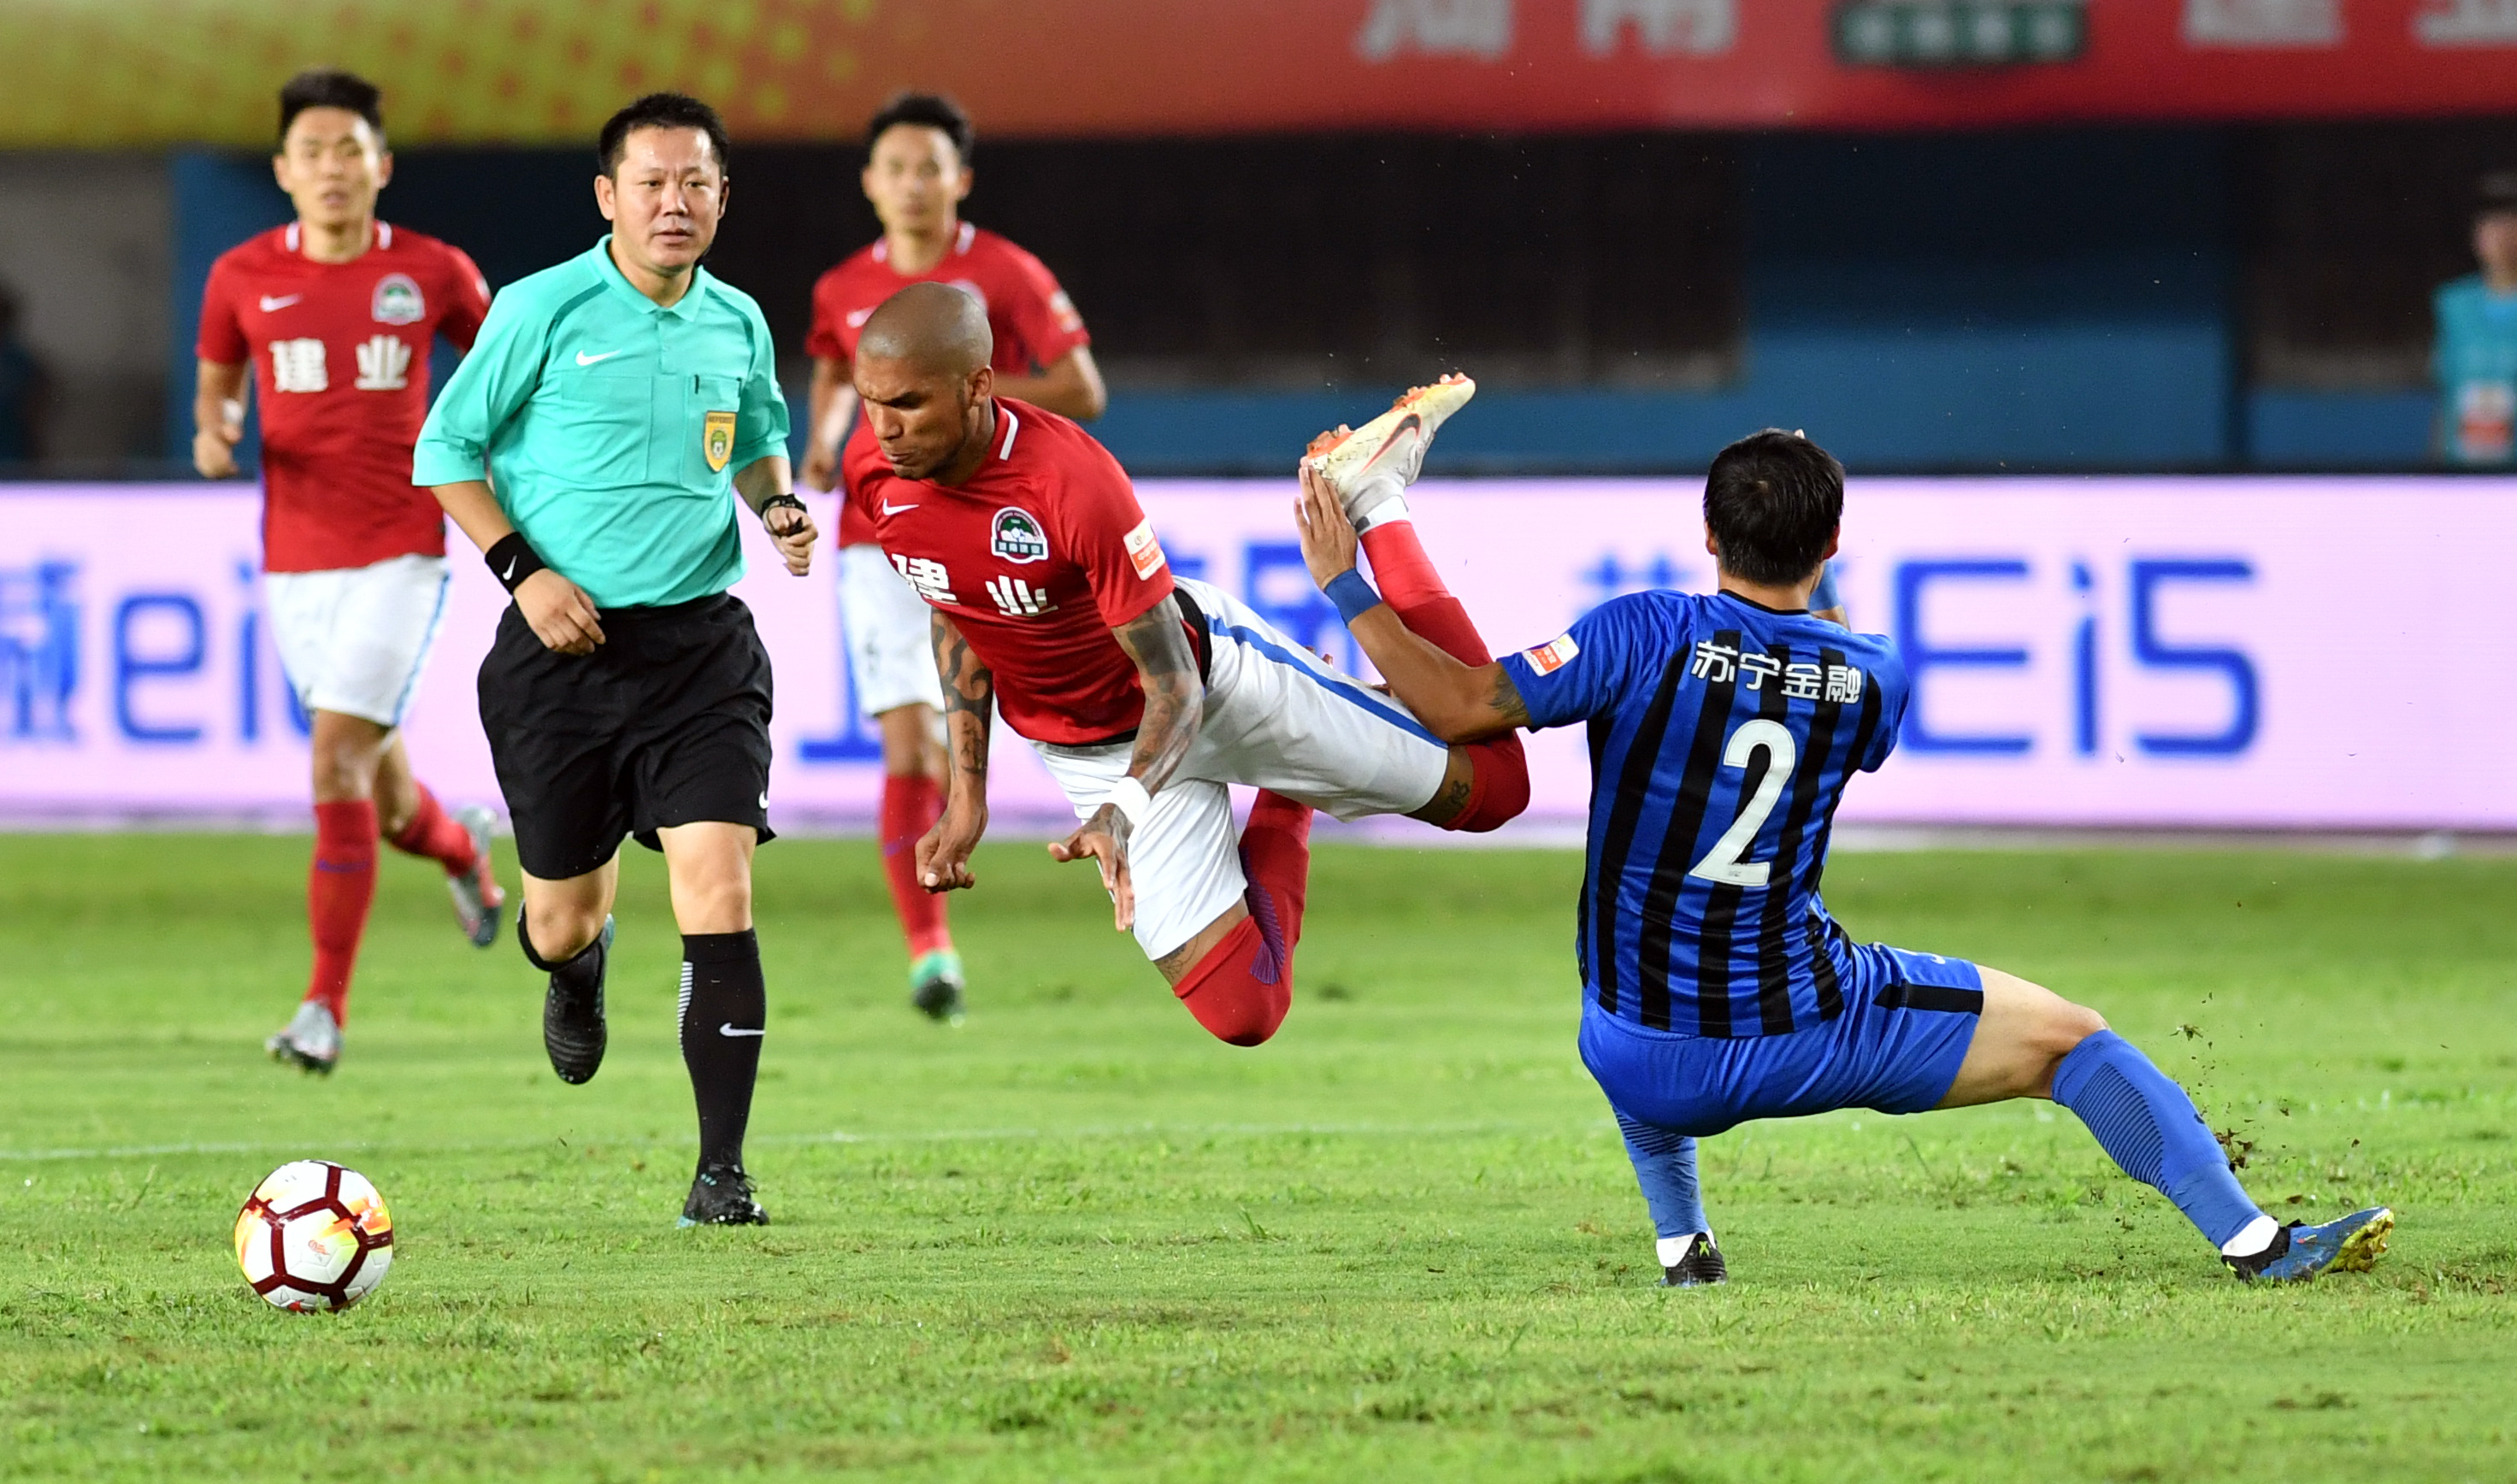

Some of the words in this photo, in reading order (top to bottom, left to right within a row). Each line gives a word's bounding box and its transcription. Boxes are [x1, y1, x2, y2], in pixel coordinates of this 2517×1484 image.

[891, 553, 1058, 616] 建业
[1690, 639, 1863, 704] 苏宁金融
[1894, 558, 2262, 756] Ei5
[1689, 719, 1795, 887] 2
